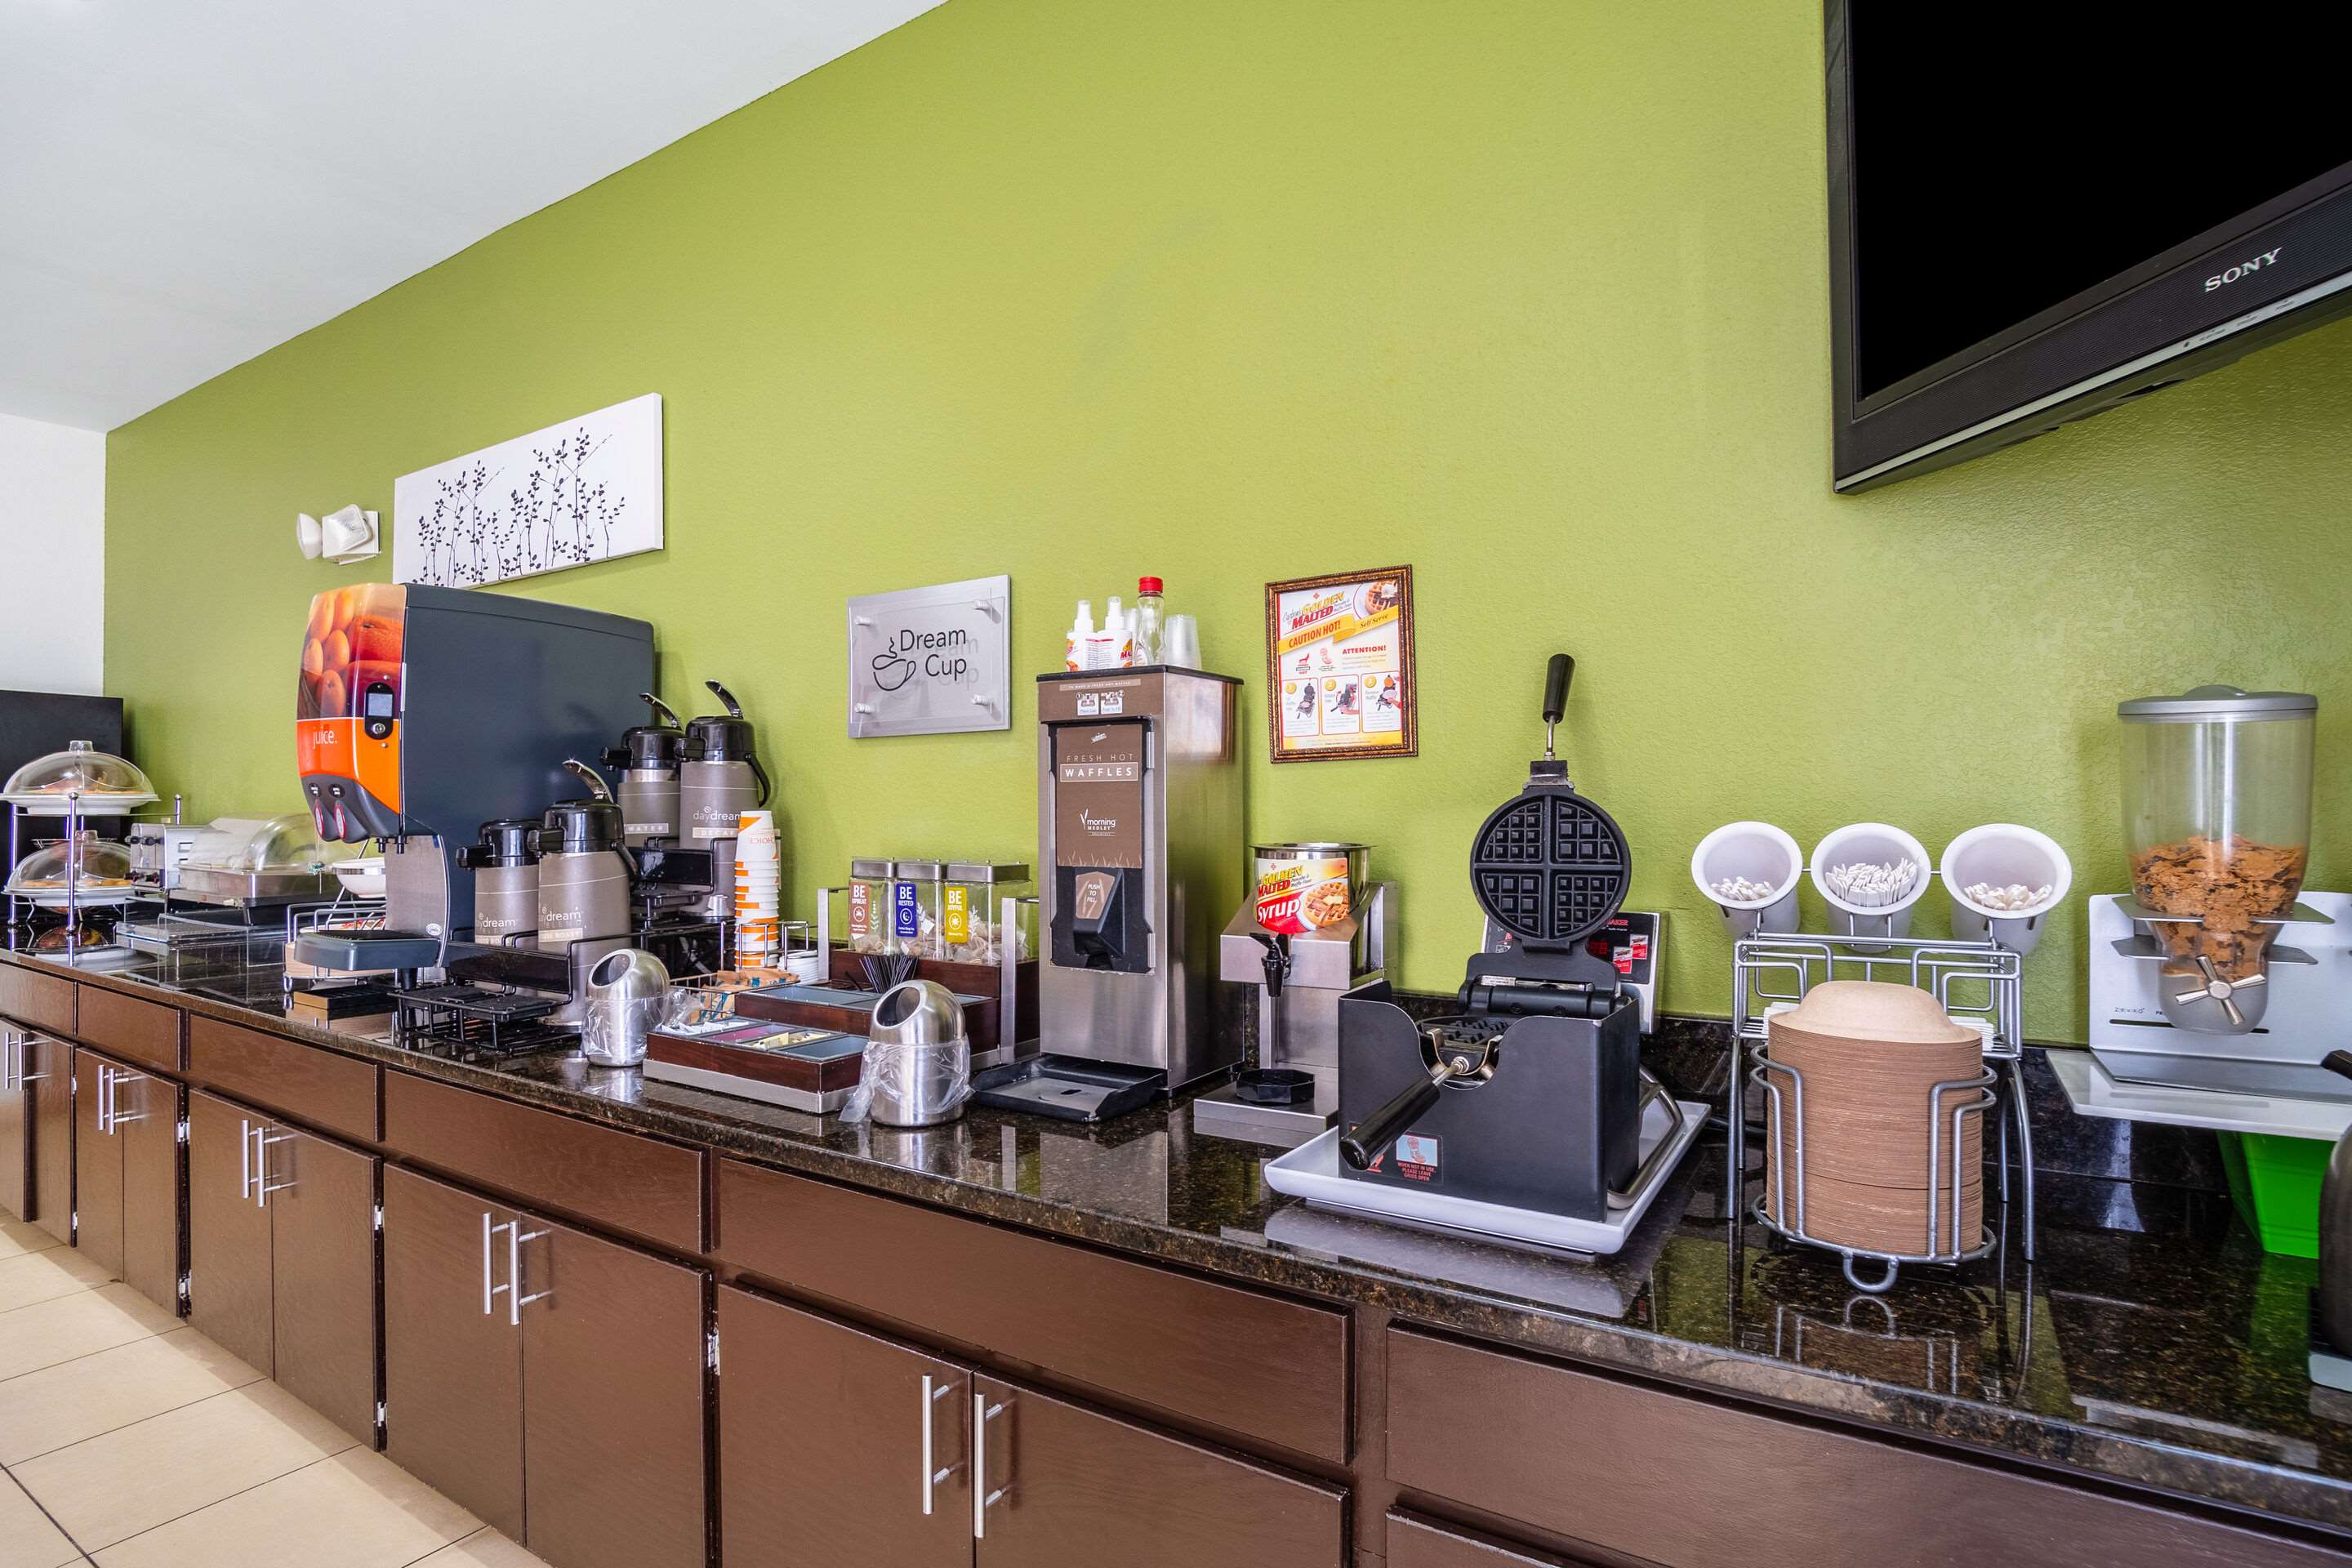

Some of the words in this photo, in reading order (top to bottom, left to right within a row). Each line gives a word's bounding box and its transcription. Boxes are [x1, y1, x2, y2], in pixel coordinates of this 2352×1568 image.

[2205, 247, 2283, 292] SONY
[1291, 605, 1334, 630] MALTED
[1359, 618, 1372, 628] Self
[1373, 613, 1388, 623] Serve
[901, 629, 966, 651] Dream
[1289, 628, 1321, 648] CAUTION
[1322, 621, 1341, 635] HOT!
[1342, 645, 1387, 654] ATTENTION!
[925, 654, 967, 681] Cup
[1067, 755, 1102, 763] FRESH
[1111, 753, 1134, 761] HOT
[1065, 768, 1133, 777] WAFFLES
[1087, 817, 1116, 828] morning
[1263, 865, 1304, 885] GOLDEN
[853, 885, 866, 898] BE
[899, 886, 912, 899] BE
[1258, 880, 1290, 897] MALTED
[948, 890, 962, 904] BE
[1258, 899, 1300, 923] Syrup
